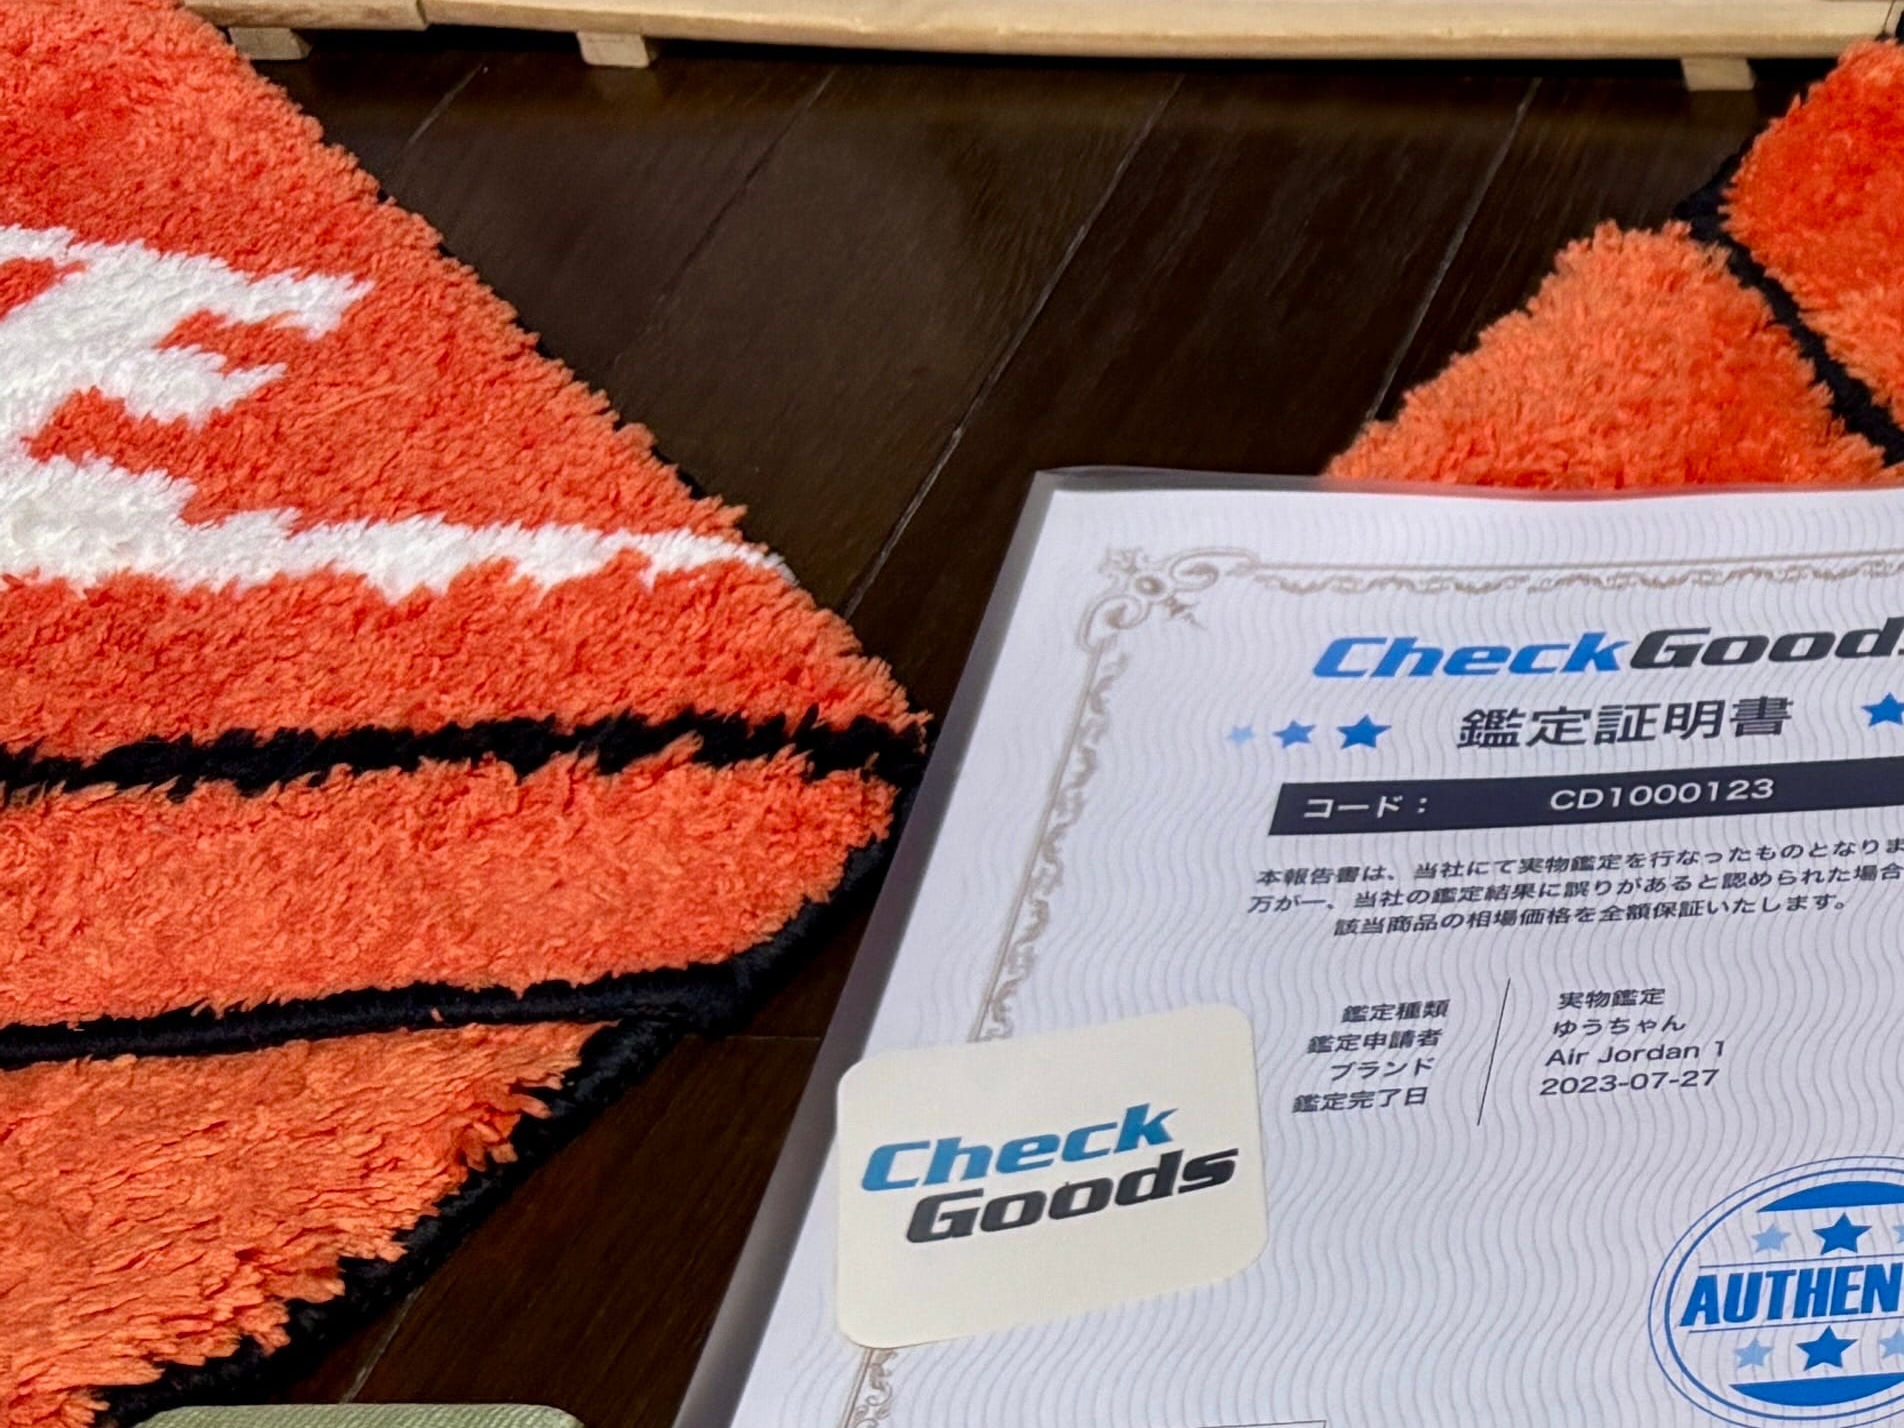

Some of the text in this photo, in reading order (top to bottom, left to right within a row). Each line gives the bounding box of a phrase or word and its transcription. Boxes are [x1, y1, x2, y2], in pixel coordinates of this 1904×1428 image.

[1456, 695, 1795, 750] 鑑定証明書
[1549, 777, 1775, 812] CD1000123
[1341, 987, 1665, 1024] 鑑定種類 実物鑑定
[1306, 1014, 1686, 1055] 鑑定申請者 ゆうちゃん
[1330, 1056, 1435, 1082] ブランド
[1545, 1040, 1726, 1068] Air Jordan 1
[1291, 1085, 1429, 1114] 鑑定完了日
[1538, 1069, 1721, 1097] 2023-07-27
[860, 1103, 1179, 1192] Check
[905, 1147, 1240, 1244] Goods
